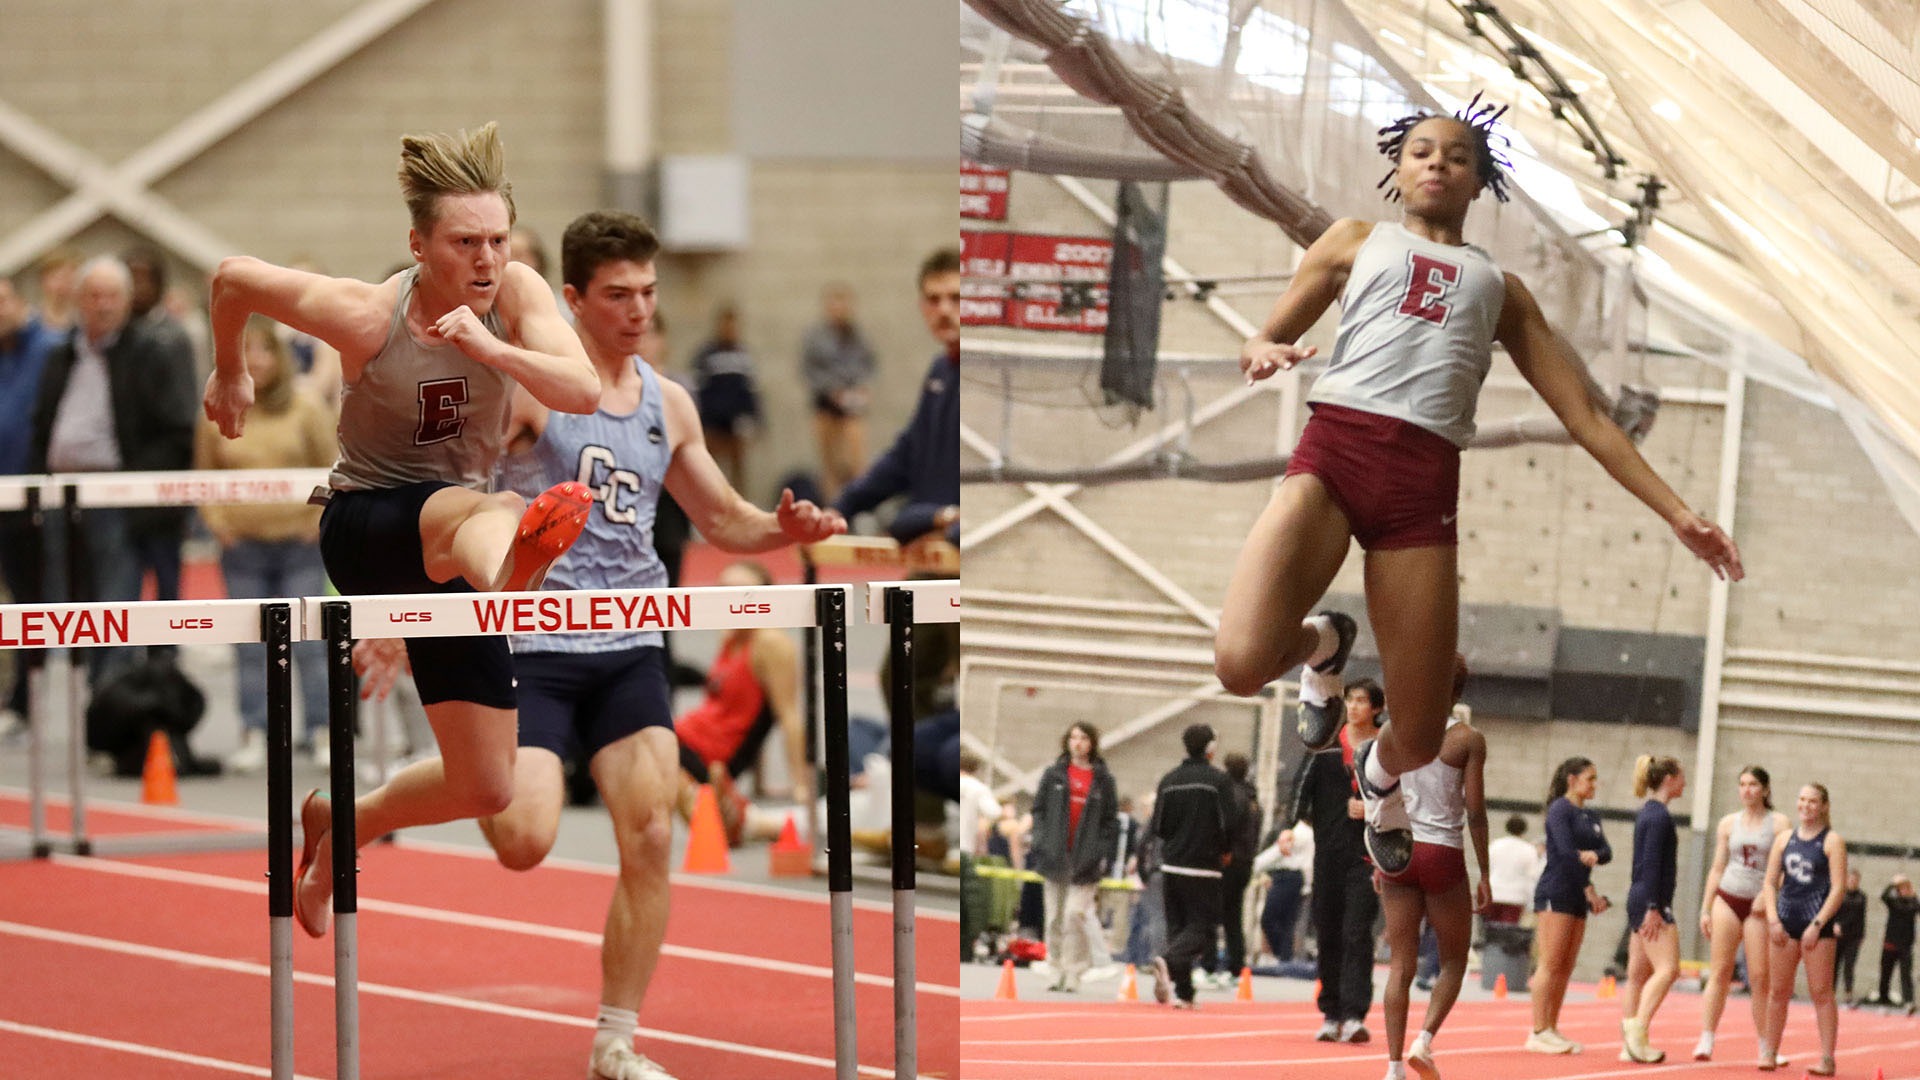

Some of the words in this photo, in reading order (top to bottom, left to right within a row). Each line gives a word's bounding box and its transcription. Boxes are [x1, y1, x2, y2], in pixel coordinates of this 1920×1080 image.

[1396, 250, 1462, 328] E
[415, 377, 468, 446] E
[578, 445, 640, 525] CC
[0, 609, 128, 646] LEYAN
[169, 618, 213, 629] UCS
[389, 611, 433, 623] UCS
[472, 594, 692, 633] WESLEYAN
[729, 603, 771, 614] UCS
[1785, 853, 1814, 883] CC
